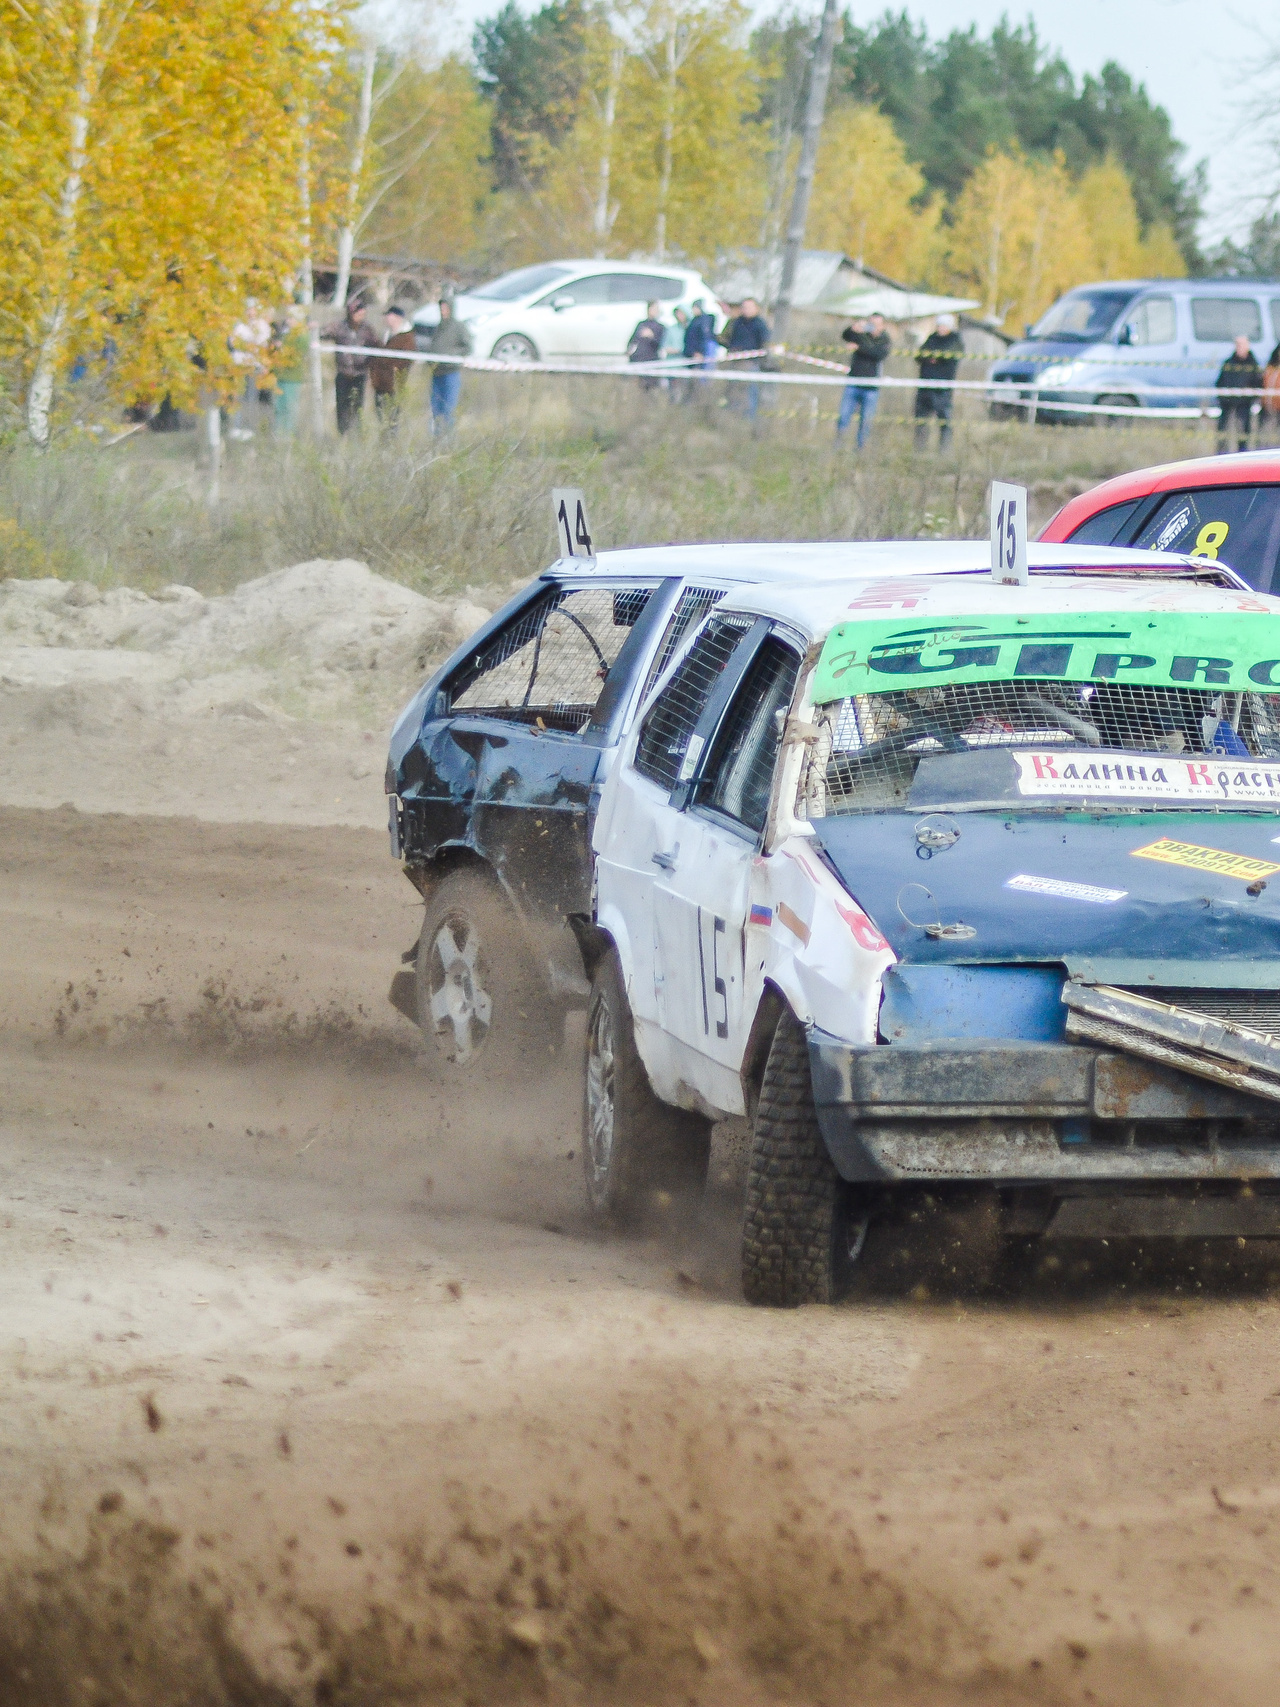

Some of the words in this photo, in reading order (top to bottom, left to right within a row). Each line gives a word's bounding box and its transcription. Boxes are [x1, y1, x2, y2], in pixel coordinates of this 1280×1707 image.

[558, 499, 592, 556] 14
[997, 500, 1016, 569] 15
[1190, 521, 1229, 560] 8
[1031, 755, 1169, 783] Калина
[1153, 841, 1278, 871] ЭВАКУАТОР
[697, 905, 728, 1039] 15
